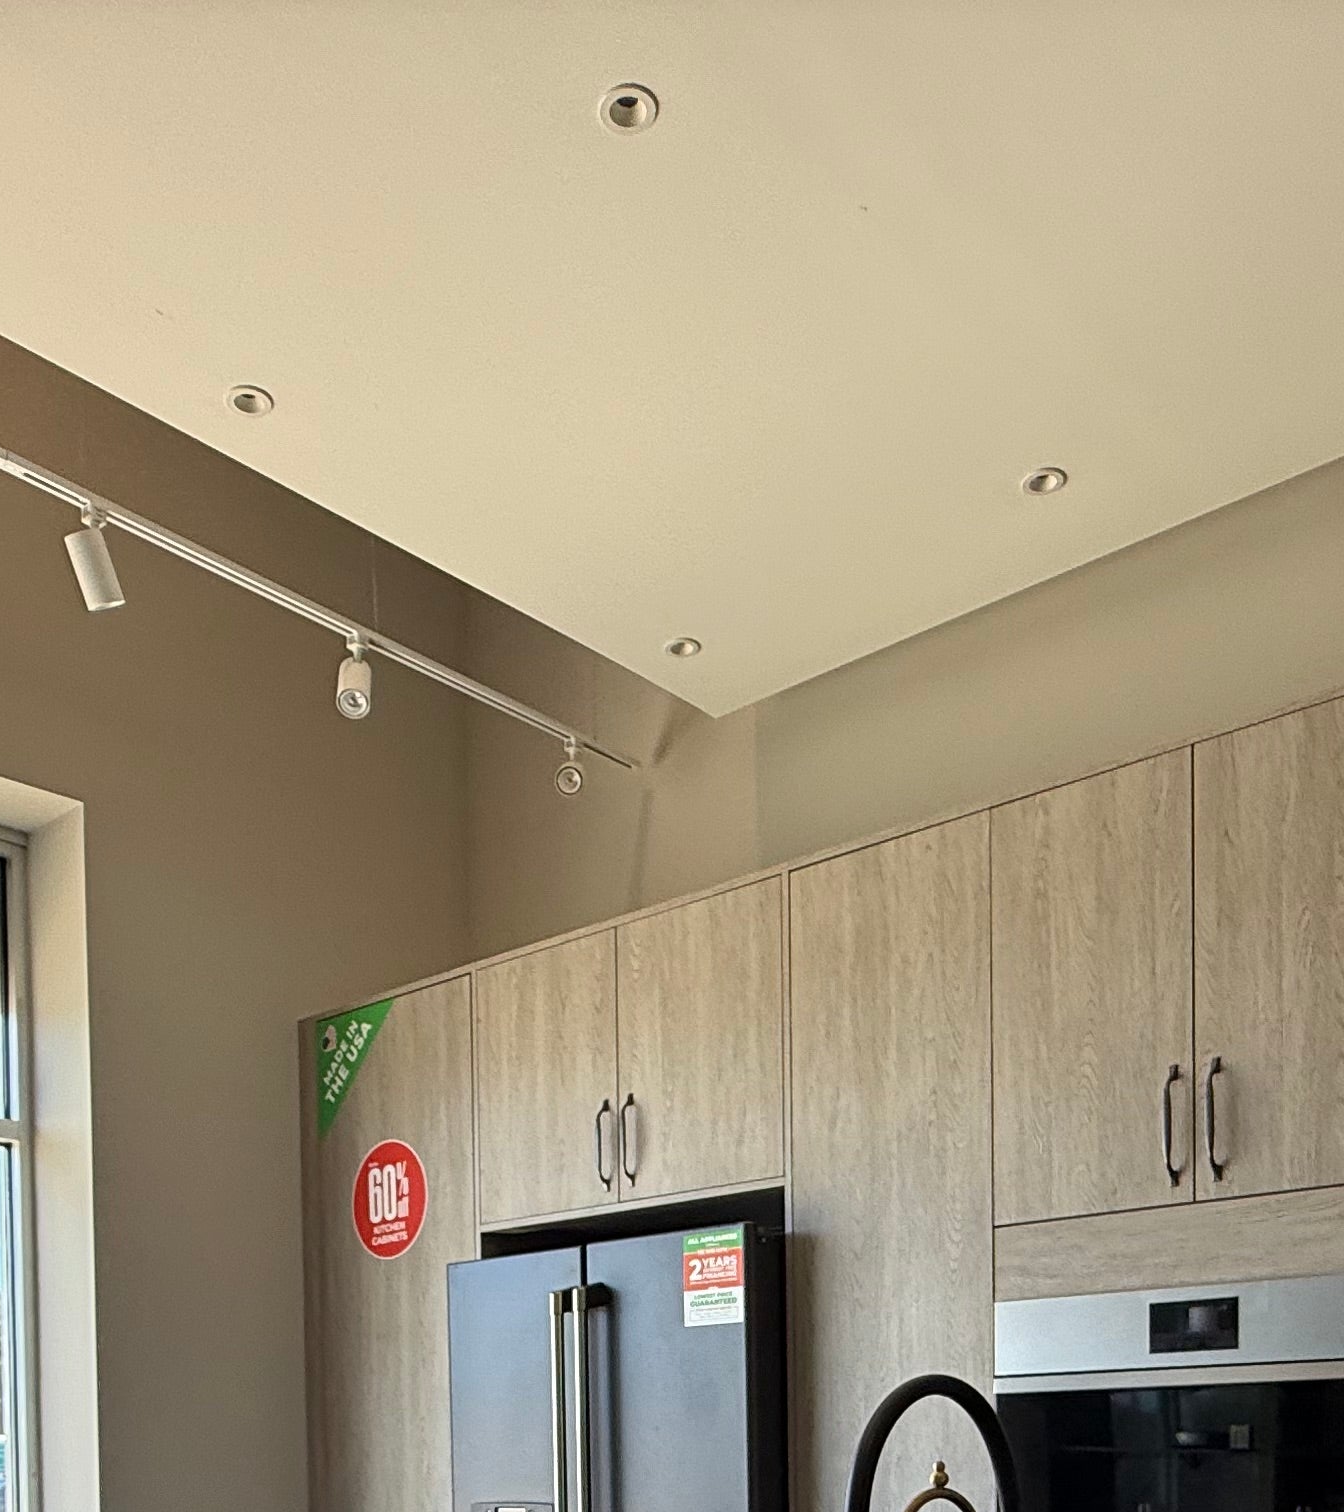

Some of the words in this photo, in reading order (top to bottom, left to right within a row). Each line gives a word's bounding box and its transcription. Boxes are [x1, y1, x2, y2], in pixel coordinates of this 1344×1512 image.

[323, 1039, 349, 1086] MADE
[346, 1020, 359, 1040] IN
[325, 1064, 350, 1104] THE
[345, 1022, 372, 1063] USA
[688, 1258, 703, 1281] 2
[702, 1256, 737, 1268] YEARS
[690, 1297, 737, 1307] GUARANTEED
